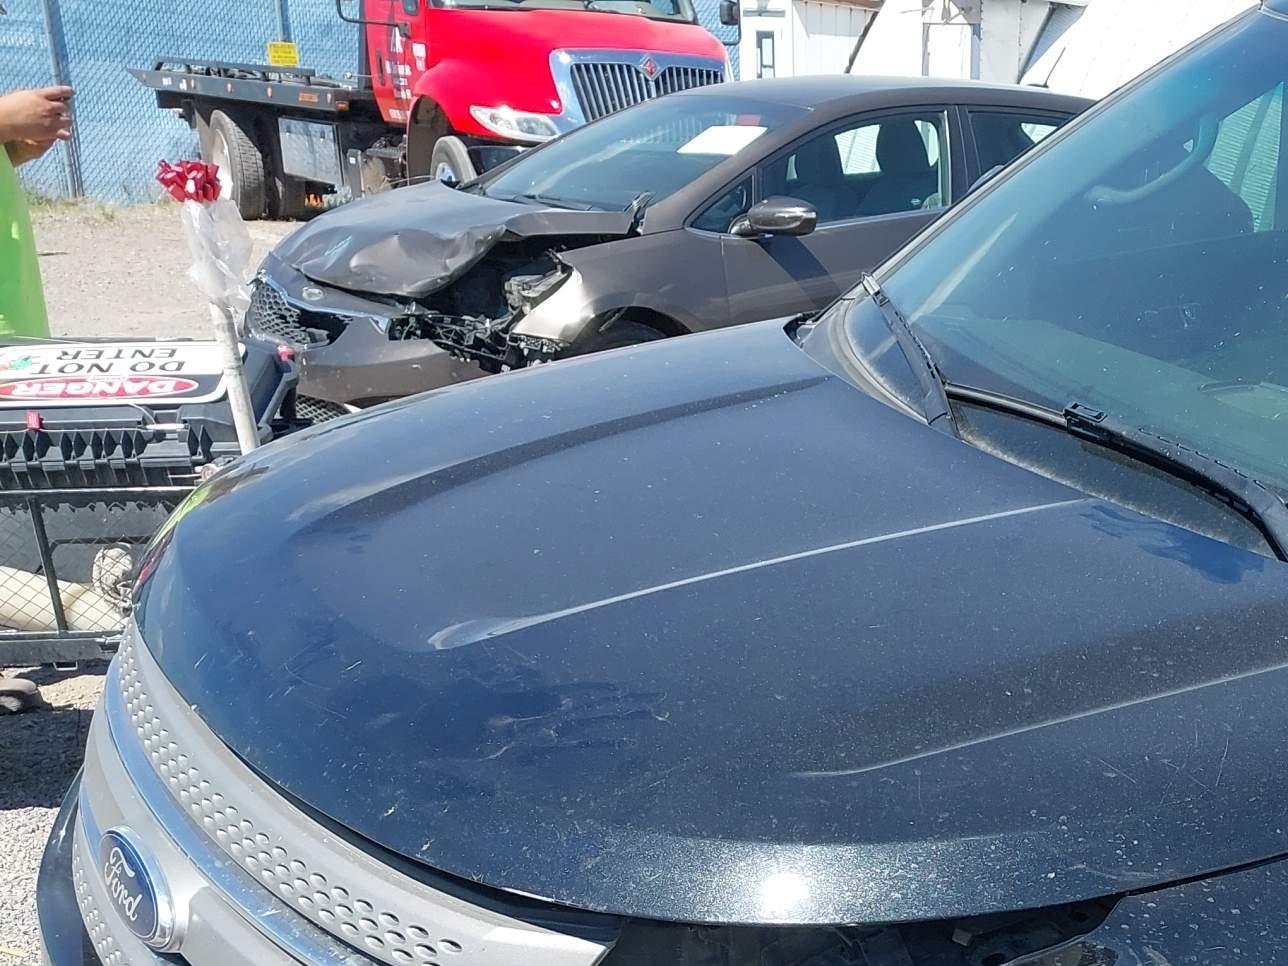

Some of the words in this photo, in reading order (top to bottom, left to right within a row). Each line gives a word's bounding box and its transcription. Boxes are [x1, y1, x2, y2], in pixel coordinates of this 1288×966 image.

[57, 348, 178, 361] ENTER
[30, 362, 114, 375] NOT
[130, 361, 186, 373] DO
[11, 381, 177, 397] DANGER
[104, 847, 142, 921] Ford
